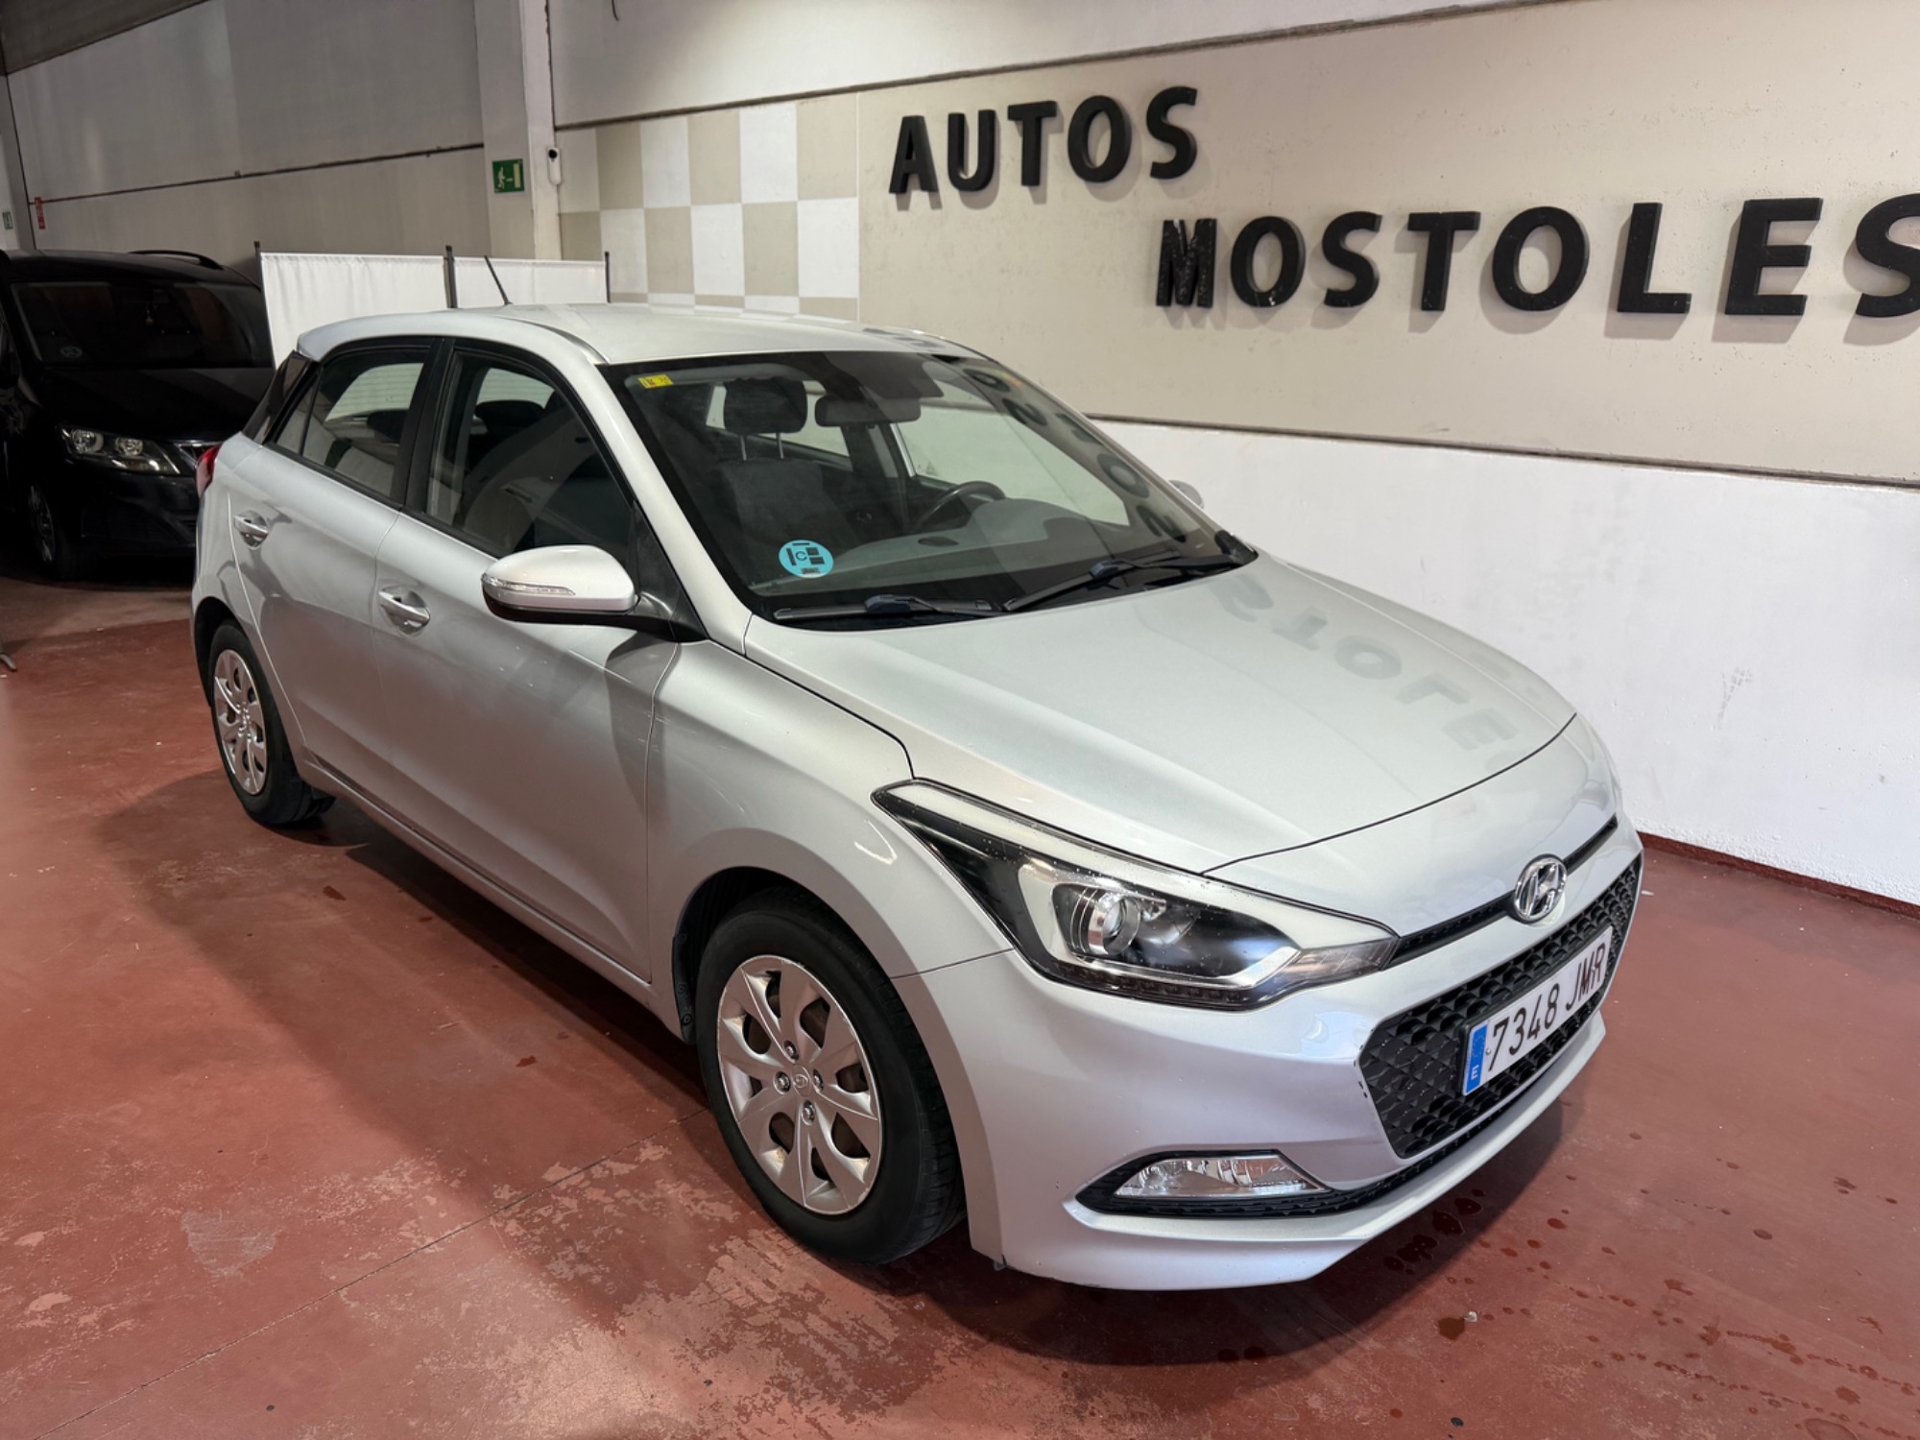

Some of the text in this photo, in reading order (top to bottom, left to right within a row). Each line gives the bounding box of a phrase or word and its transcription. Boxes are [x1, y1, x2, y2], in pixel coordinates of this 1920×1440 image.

[889, 86, 1198, 194] AUTOS
[1156, 193, 1920, 318] MOSTOLES
[1488, 942, 1606, 1072] 7348 JMR
